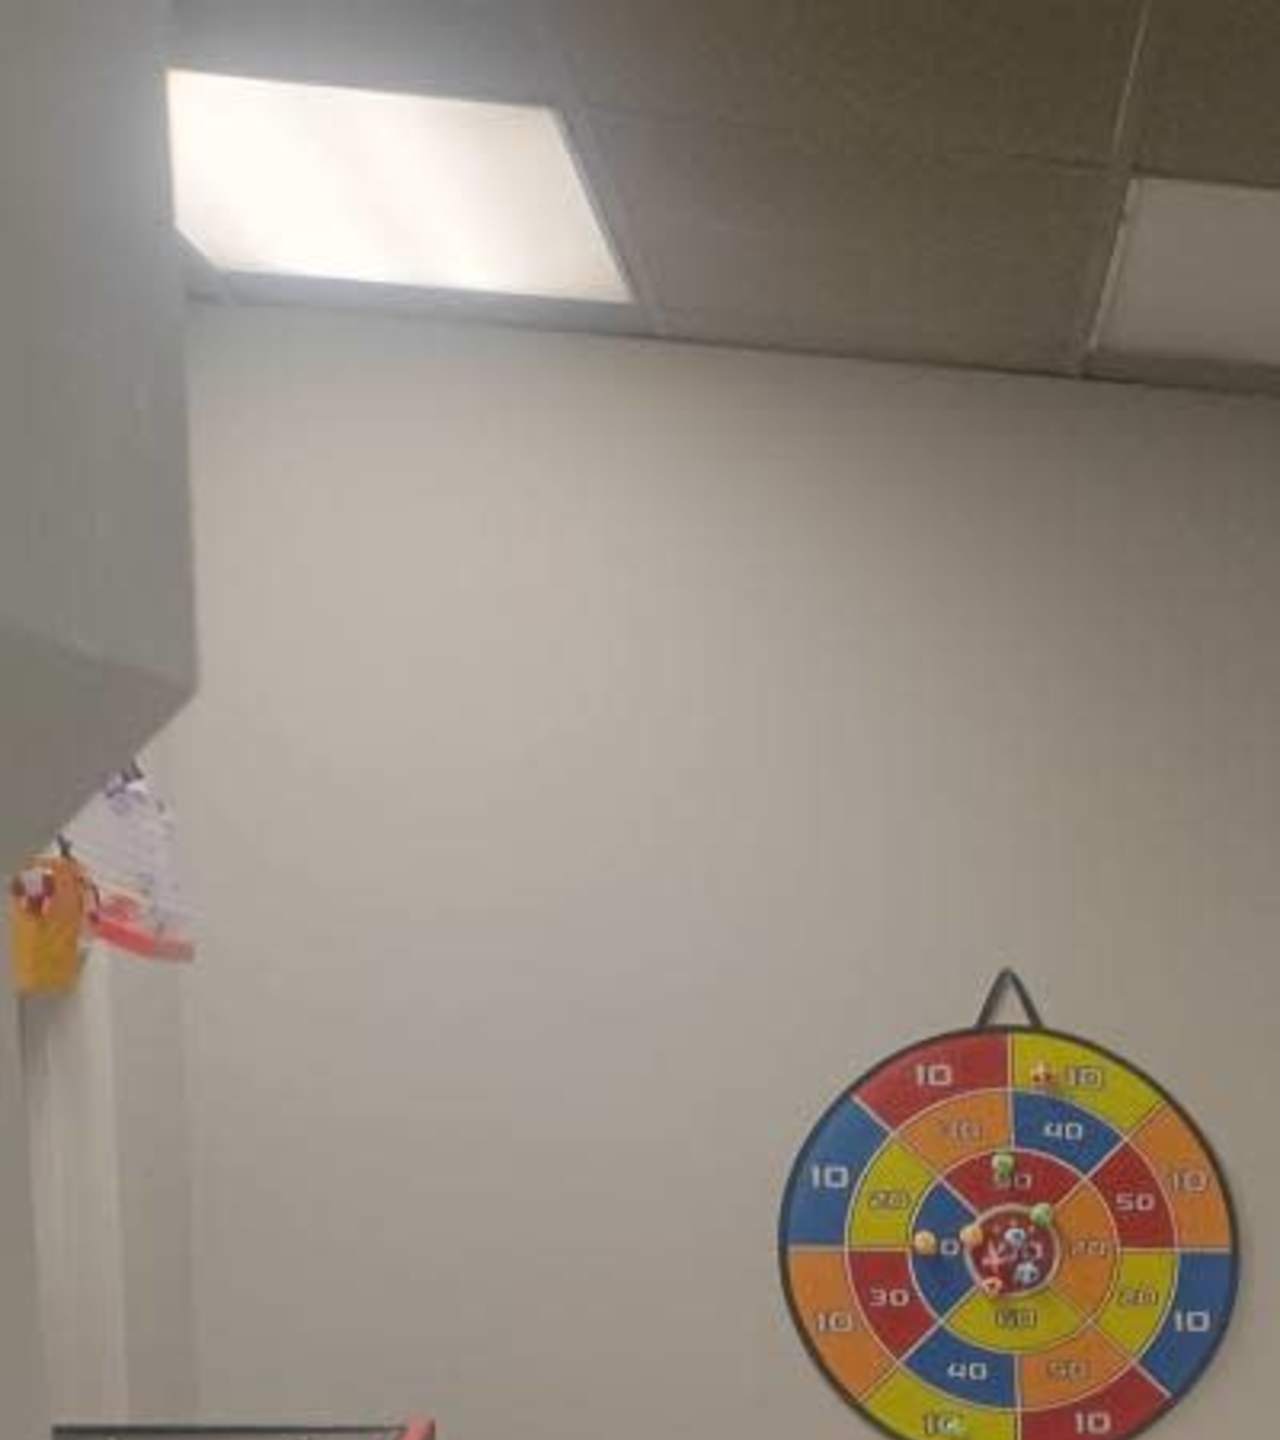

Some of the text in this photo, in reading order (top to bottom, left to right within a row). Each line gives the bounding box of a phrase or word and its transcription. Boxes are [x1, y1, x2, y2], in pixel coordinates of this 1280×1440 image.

[915, 1064, 953, 1086] 10
[1069, 1068, 1102, 1087] 10
[1044, 1123, 1083, 1141] 40
[811, 1165, 849, 1188] 10
[1174, 1172, 1207, 1192] 10
[1116, 1193, 1156, 1211] 50
[870, 1289, 910, 1308] 30
[817, 1312, 853, 1332] 10
[1174, 1311, 1211, 1333] 10
[947, 1363, 989, 1381] 40
[1074, 1412, 1112, 1435] 10
